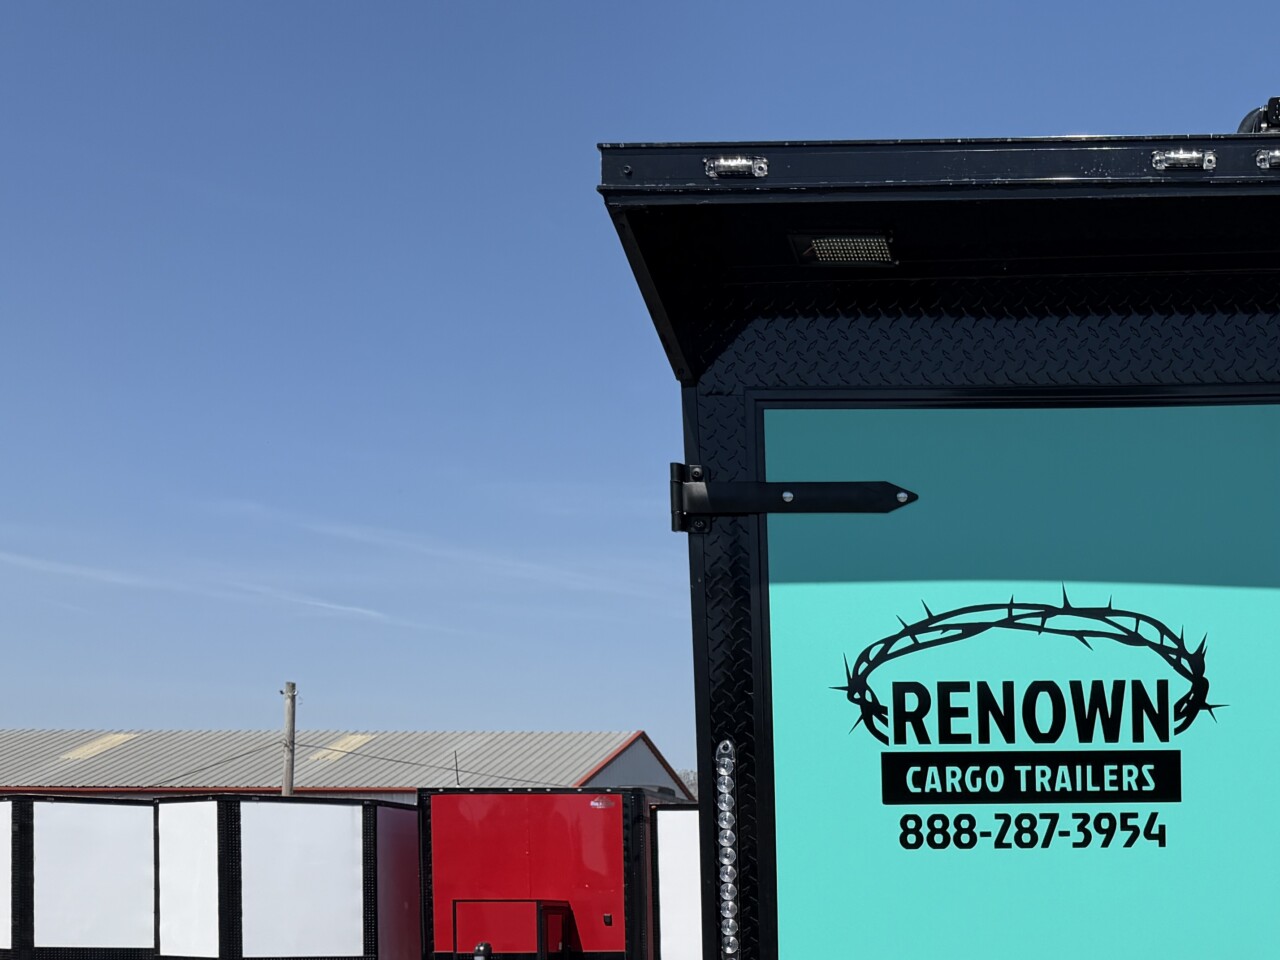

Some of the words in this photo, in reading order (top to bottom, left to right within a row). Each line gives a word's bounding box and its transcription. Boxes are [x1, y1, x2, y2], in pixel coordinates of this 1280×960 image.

[892, 679, 1170, 745] RENOWN
[905, 765, 1005, 793] CARGO
[1014, 764, 1156, 792] TRAILERS
[899, 811, 1167, 850] 888-287-3954
